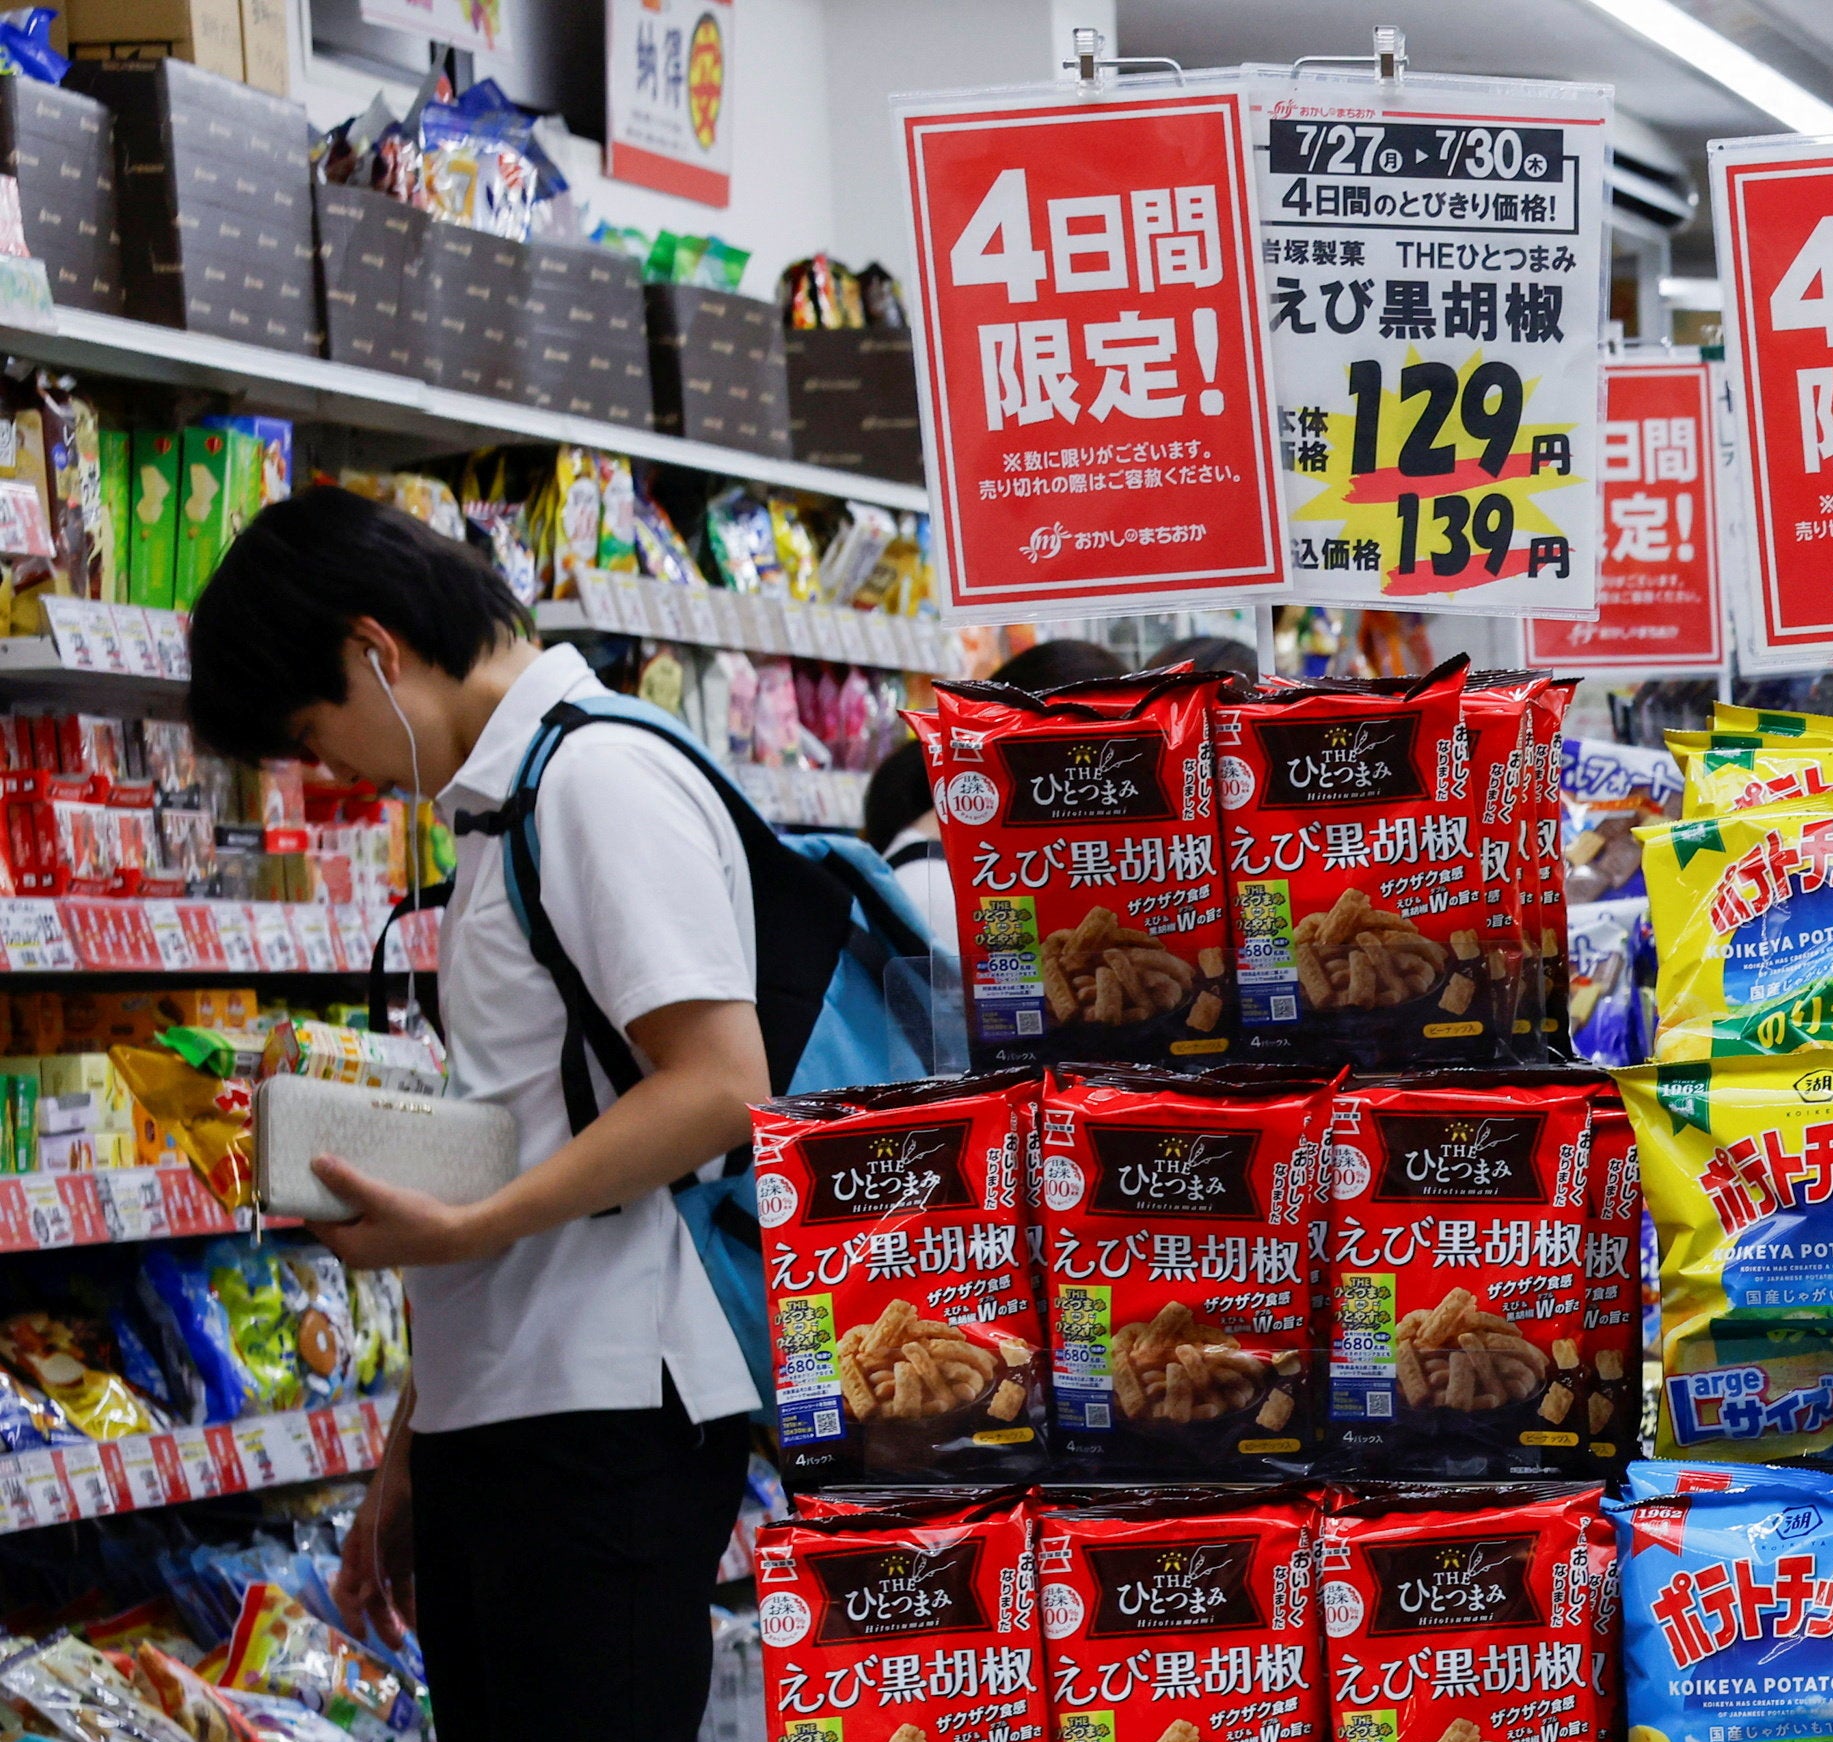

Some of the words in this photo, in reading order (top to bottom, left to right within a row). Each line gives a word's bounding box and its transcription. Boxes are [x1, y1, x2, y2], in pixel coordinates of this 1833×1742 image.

[1281, 178, 1557, 223] 4日間のとびきり価格!
[950, 168, 1224, 303] 4日間
[1395, 241, 1577, 274] THEひとつまみ
[1272, 277, 1564, 344] えび黒胡椒
[978, 308, 1224, 431] 限定!
[978, 464, 1241, 501] 売り切れの際はご容赦ください。
[1031, 773, 1139, 806] ひとつまみ
[1065, 768, 1102, 780] THE
[971, 835, 1217, 891] えび黒胡椒
[1128, 886, 1210, 915] ザクザク食感
[1053, 1228, 1302, 1286] えび黒胡椒
[1669, 1677, 1758, 1694] KOIKEYA
